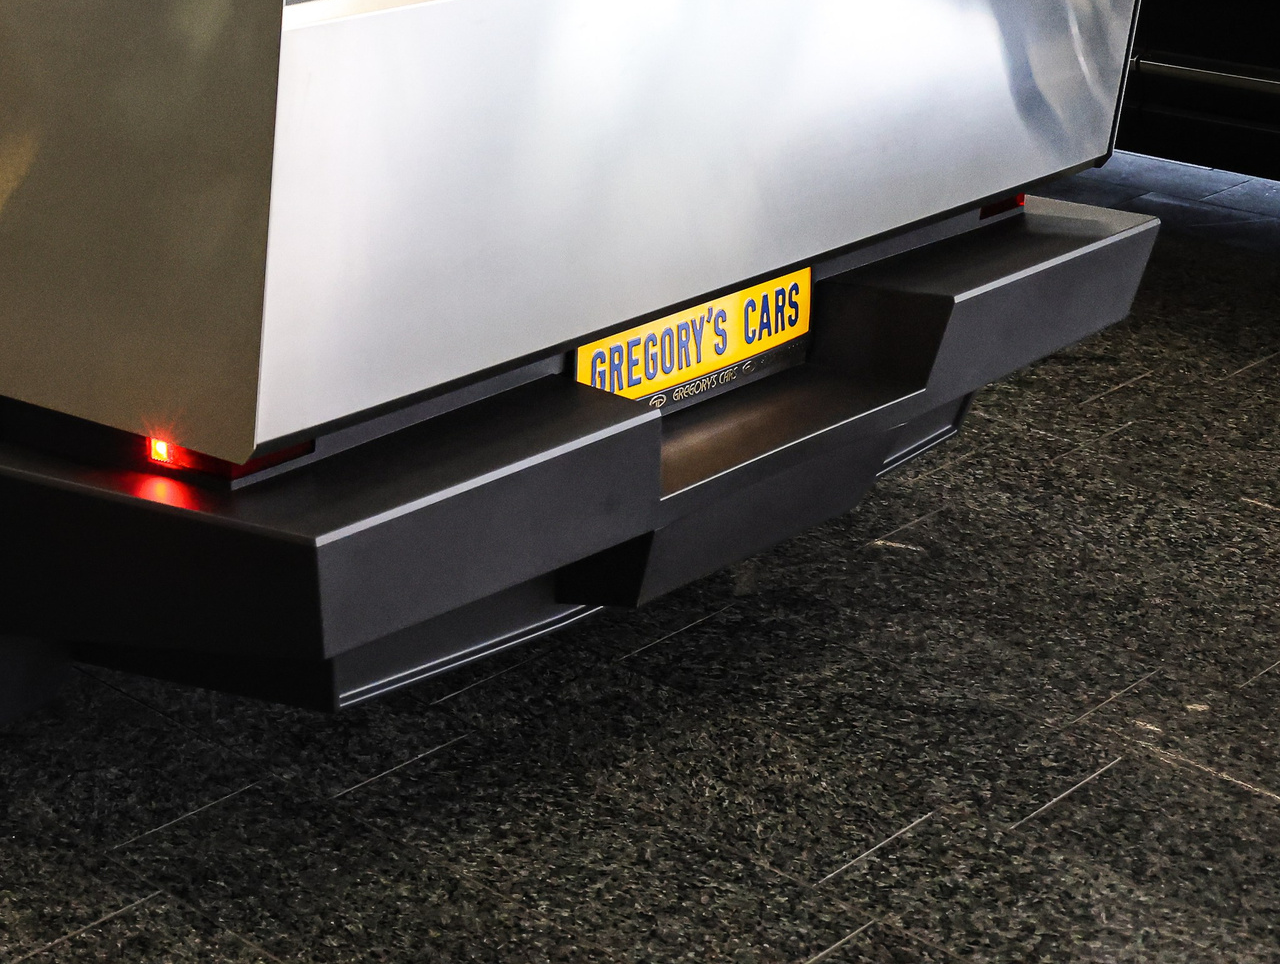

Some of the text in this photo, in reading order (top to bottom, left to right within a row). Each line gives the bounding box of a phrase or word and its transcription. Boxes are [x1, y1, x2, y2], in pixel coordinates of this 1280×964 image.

[591, 306, 727, 393] GREGORY'S
[743, 282, 800, 345] CARS
[718, 366, 739, 385] CARS
